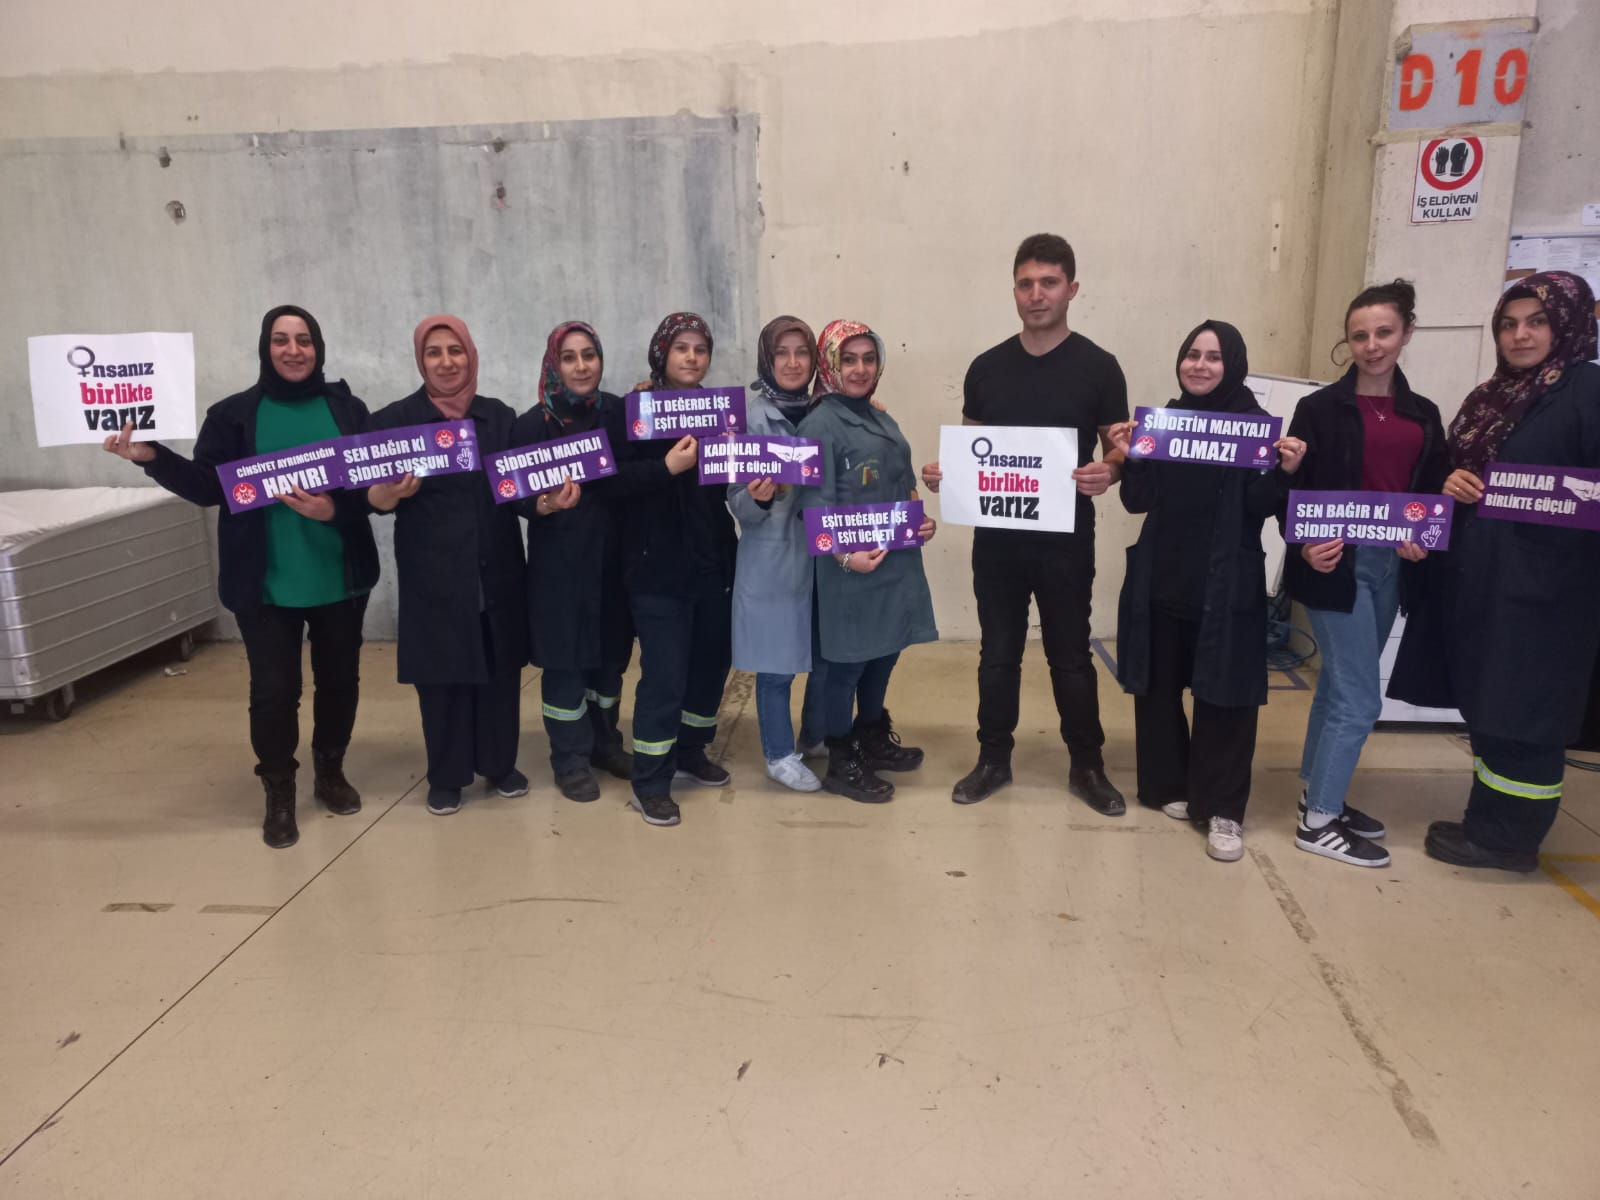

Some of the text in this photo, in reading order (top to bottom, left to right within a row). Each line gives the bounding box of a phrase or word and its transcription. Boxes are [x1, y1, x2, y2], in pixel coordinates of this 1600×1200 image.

[1416, 191, 1479, 207] İŞ ELDİVENİ
[1422, 207, 1471, 219] KULLAN
[80, 382, 153, 405] birlikte
[664, 396, 711, 412] DEĞERDE
[713, 394, 730, 411] İŞE
[84, 405, 156, 431] varız
[654, 413, 717, 433] EŞİT ÜCRET!
[1143, 413, 1271, 438] ŞİDDETİN MAKYAJI
[343, 435, 426, 464] SEN BAĞIR Kİ
[495, 436, 602, 476] ŞİDDETİN MAKYAJI
[704, 442, 760, 458] KADINLAR
[1168, 437, 1238, 462] OLMAZ!
[236, 460, 277, 479] CİNSİYET
[348, 454, 450, 485] ŞİDDET SUSSUN!
[527, 461, 586, 491] OLMAZ!
[746, 460, 782, 476] GÜÇLÜ!
[262, 465, 329, 499] HAYIR!
[978, 471, 1039, 493] birlikte
[1489, 471, 1555, 491] KADINLAR
[979, 495, 1040, 520] varız
[1296, 503, 1324, 518] SEN
[1326, 502, 1370, 519] BAĞIR
[1373, 504, 1390, 520] Kİ
[1484, 493, 1577, 515] BİRLİKTE GÜÇLÜ!
[822, 509, 908, 529] EŞİT DEĞERDE İŞE
[837, 528, 895, 546] EŞİT ÜCRET!
[1295, 521, 1412, 542] ŞİDDET SUSSUN!
